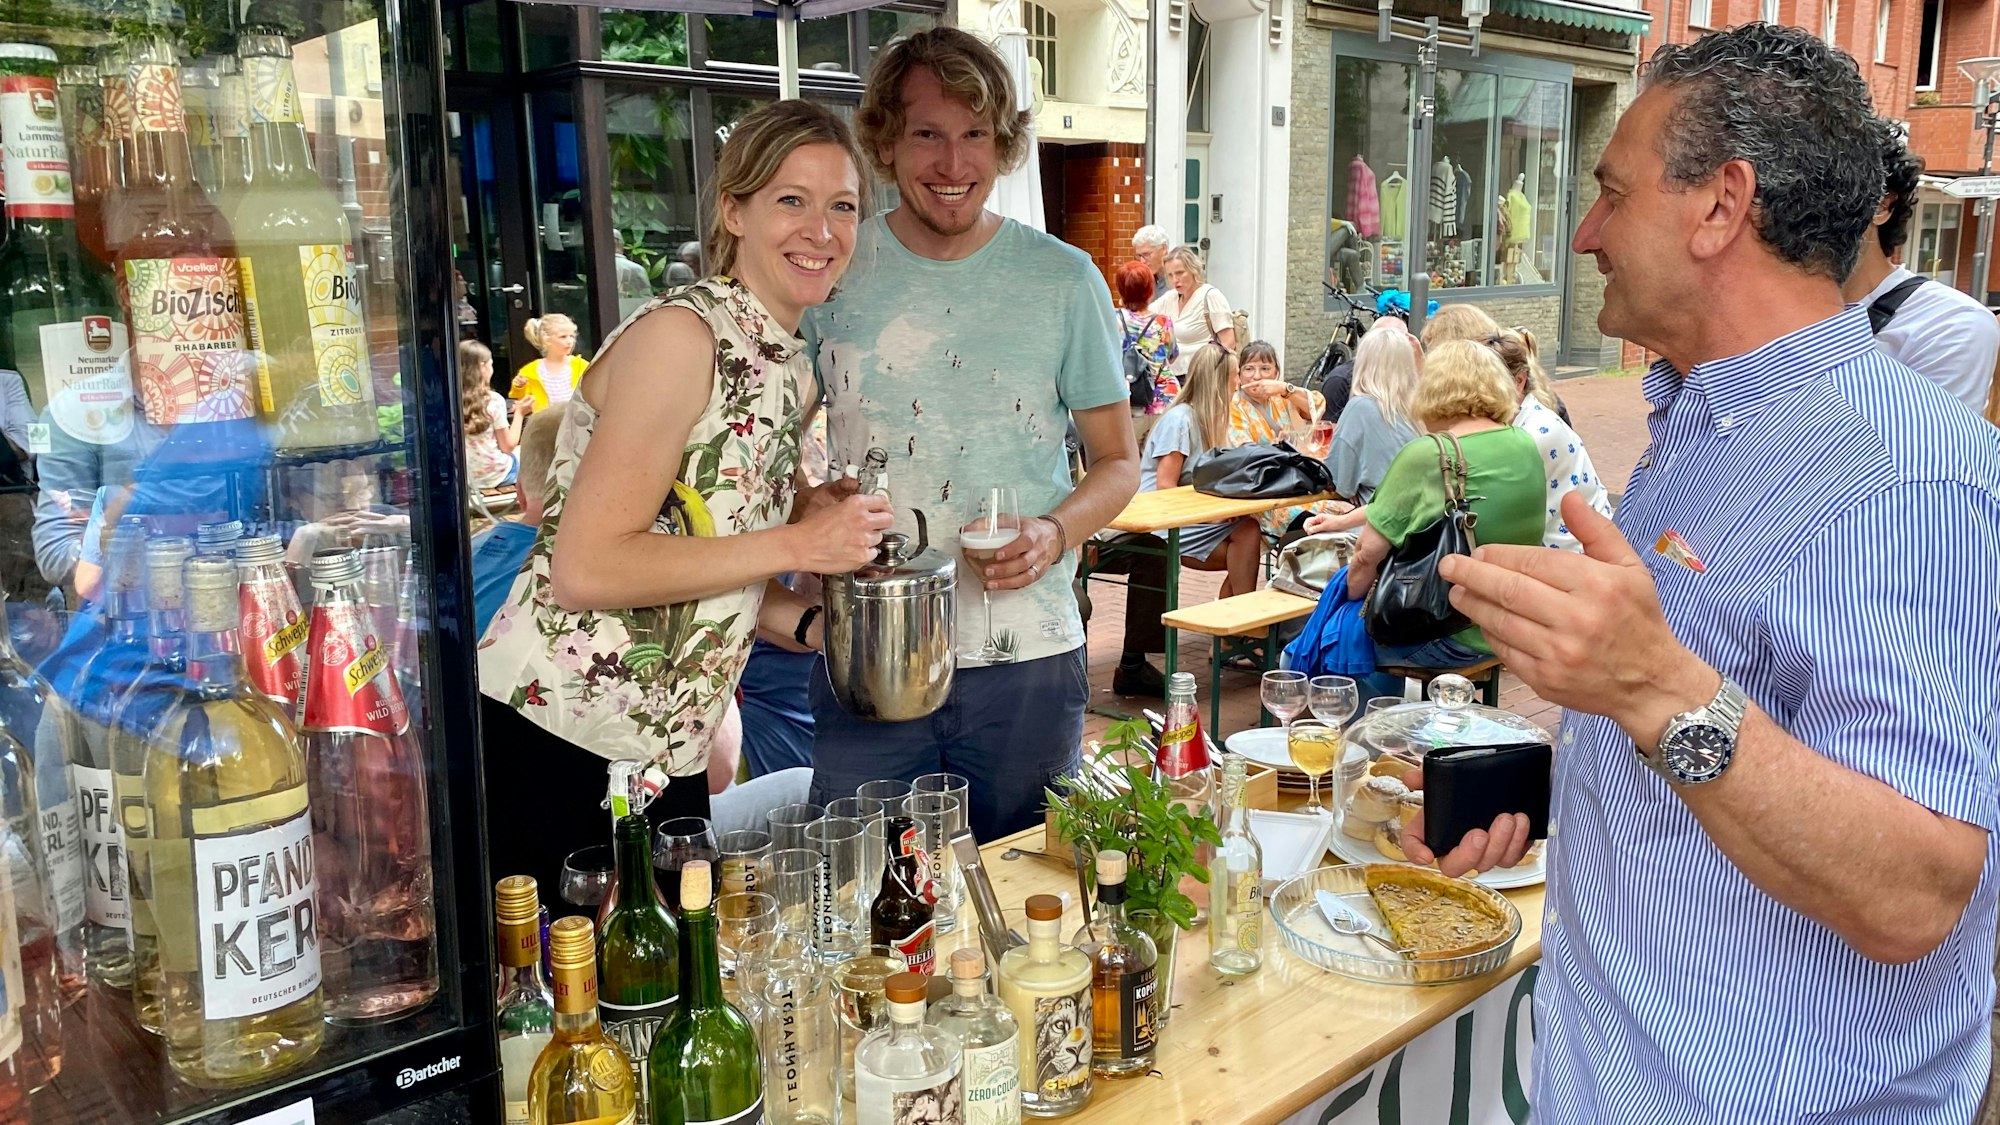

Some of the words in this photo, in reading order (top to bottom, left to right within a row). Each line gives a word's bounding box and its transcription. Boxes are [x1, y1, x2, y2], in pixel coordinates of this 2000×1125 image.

[1276, 111, 1283, 121] 10
[177, 262, 219, 273] Voelkel
[152, 287, 242, 322] BioZisch
[174, 341, 238, 352] RHABARBER
[366, 707, 389, 722] WILD
[252, 986, 298, 1004] DEUTSCHER
[396, 1055, 462, 1090] Bartscher
[968, 1086, 991, 1102] ZÉRO
